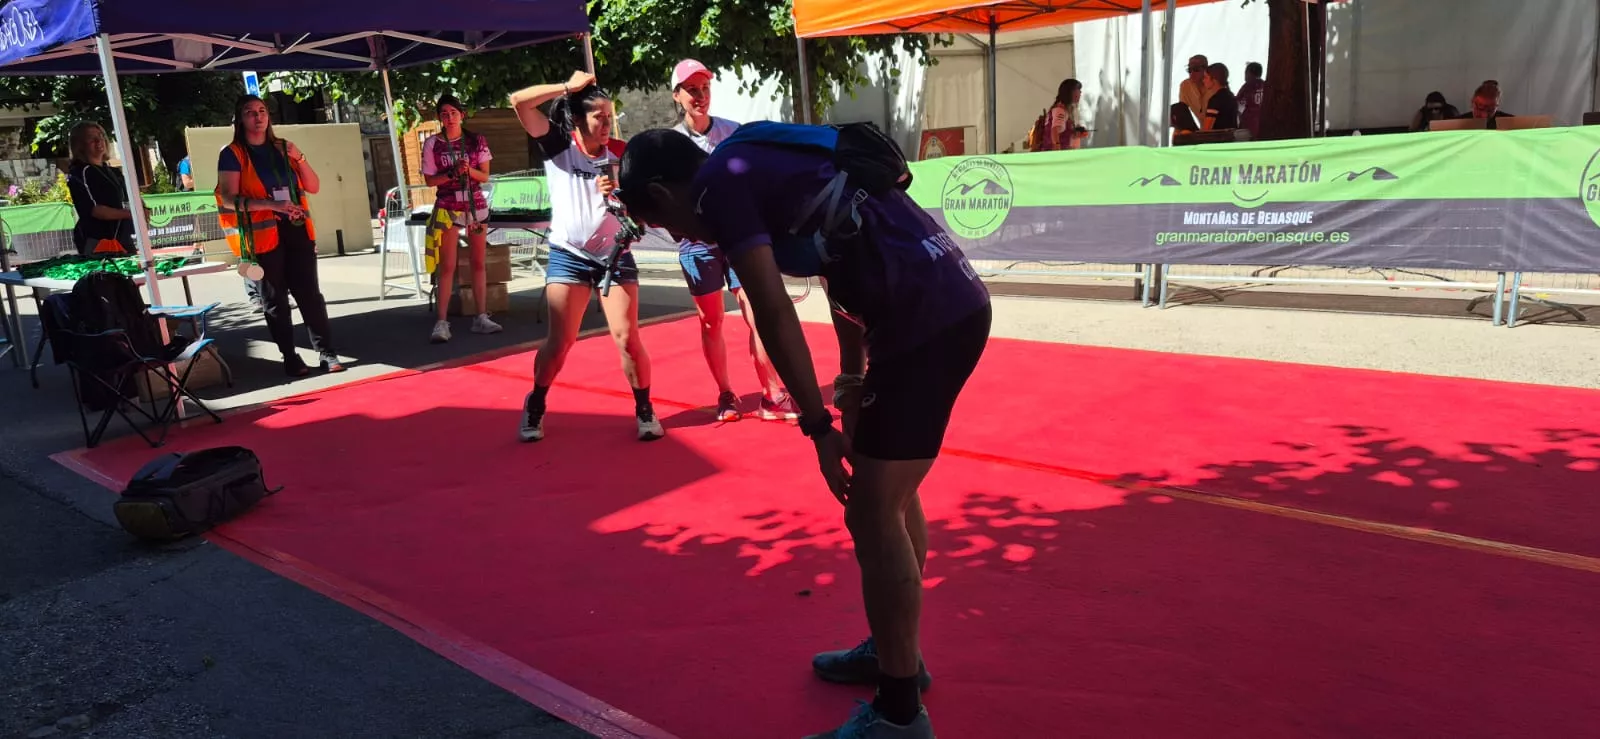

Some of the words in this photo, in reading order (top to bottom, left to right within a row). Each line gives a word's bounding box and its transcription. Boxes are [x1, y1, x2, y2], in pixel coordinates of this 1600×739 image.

[1189, 165, 1232, 185] GRAN
[1237, 161, 1322, 185] MARATÓN
[945, 198, 966, 210] GRAN
[1183, 211, 1239, 225] MONTAÑAS
[1241, 212, 1256, 225] DE
[1257, 211, 1314, 226] BENASQUE
[1155, 229, 1350, 245] granmaratonbenasque.es
